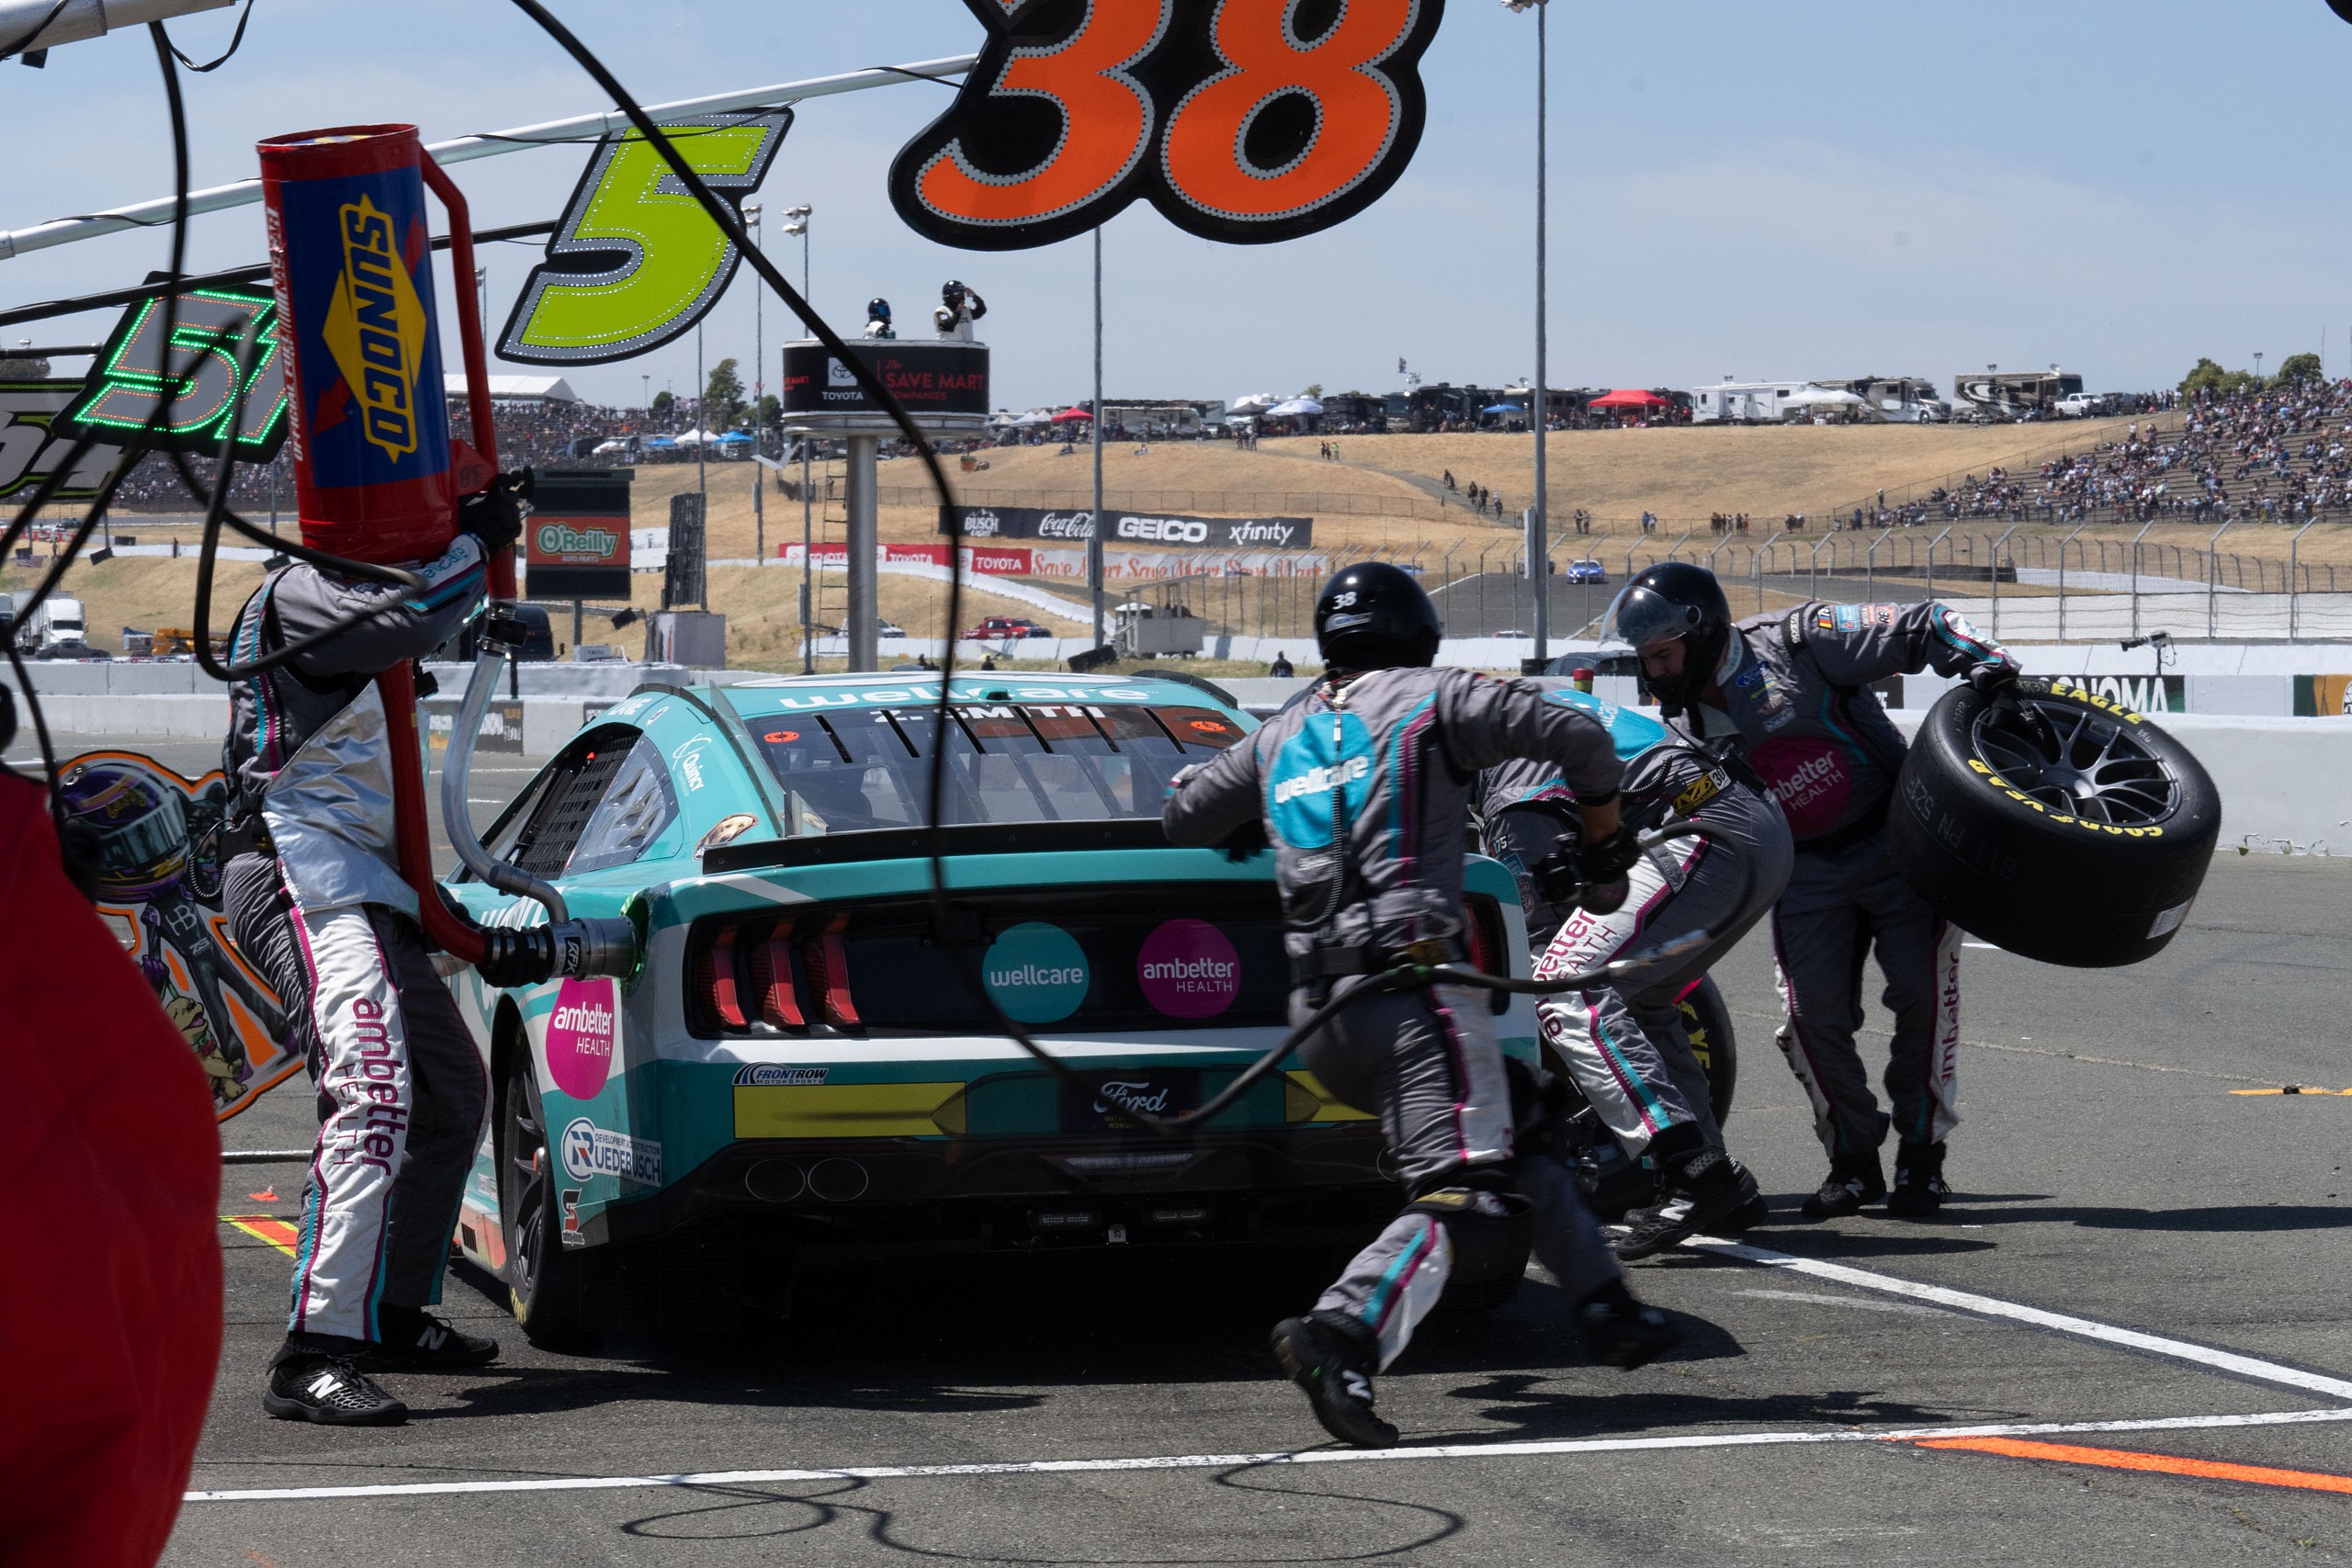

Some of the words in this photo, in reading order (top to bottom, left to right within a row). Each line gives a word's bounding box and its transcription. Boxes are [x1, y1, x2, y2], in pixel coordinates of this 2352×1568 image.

[916, 0, 1421, 225] 38
[502, 112, 790, 361] 5
[347, 206, 413, 449] SUNOCO
[886, 373, 933, 389] SAVE
[938, 374, 984, 390] MART
[822, 391, 864, 400] TOYOTA
[965, 516, 999, 533] BUSCH
[1117, 516, 1208, 543] GEICO
[1228, 521, 1294, 546] xfinity
[539, 524, 616, 557] O'Reilly
[976, 556, 1022, 570] TOYOTA
[1033, 553, 1071, 577] Save
[1127, 558, 1169, 578] Save
[1332, 592, 1357, 610] 38
[779, 687, 1150, 708] wellcare
[2051, 682, 2146, 725] EAGLE
[1791, 769, 1845, 811] HEALTH
[1495, 835, 1508, 850] 75
[564, 940, 580, 974] RFK
[1556, 924, 1618, 980] EALTH
[989, 964, 1083, 987] wellcare
[1143, 956, 1234, 980] ambetter
[1176, 981, 1234, 993] HEALTH
[553, 1001, 613, 1036] ambetter
[576, 1037, 610, 1057] HEALTH
[353, 998, 408, 1177] ambetter
[1094, 1081, 1170, 1114] Ford
[416, 1325, 447, 1350] N
[307, 1373, 344, 1400] N
